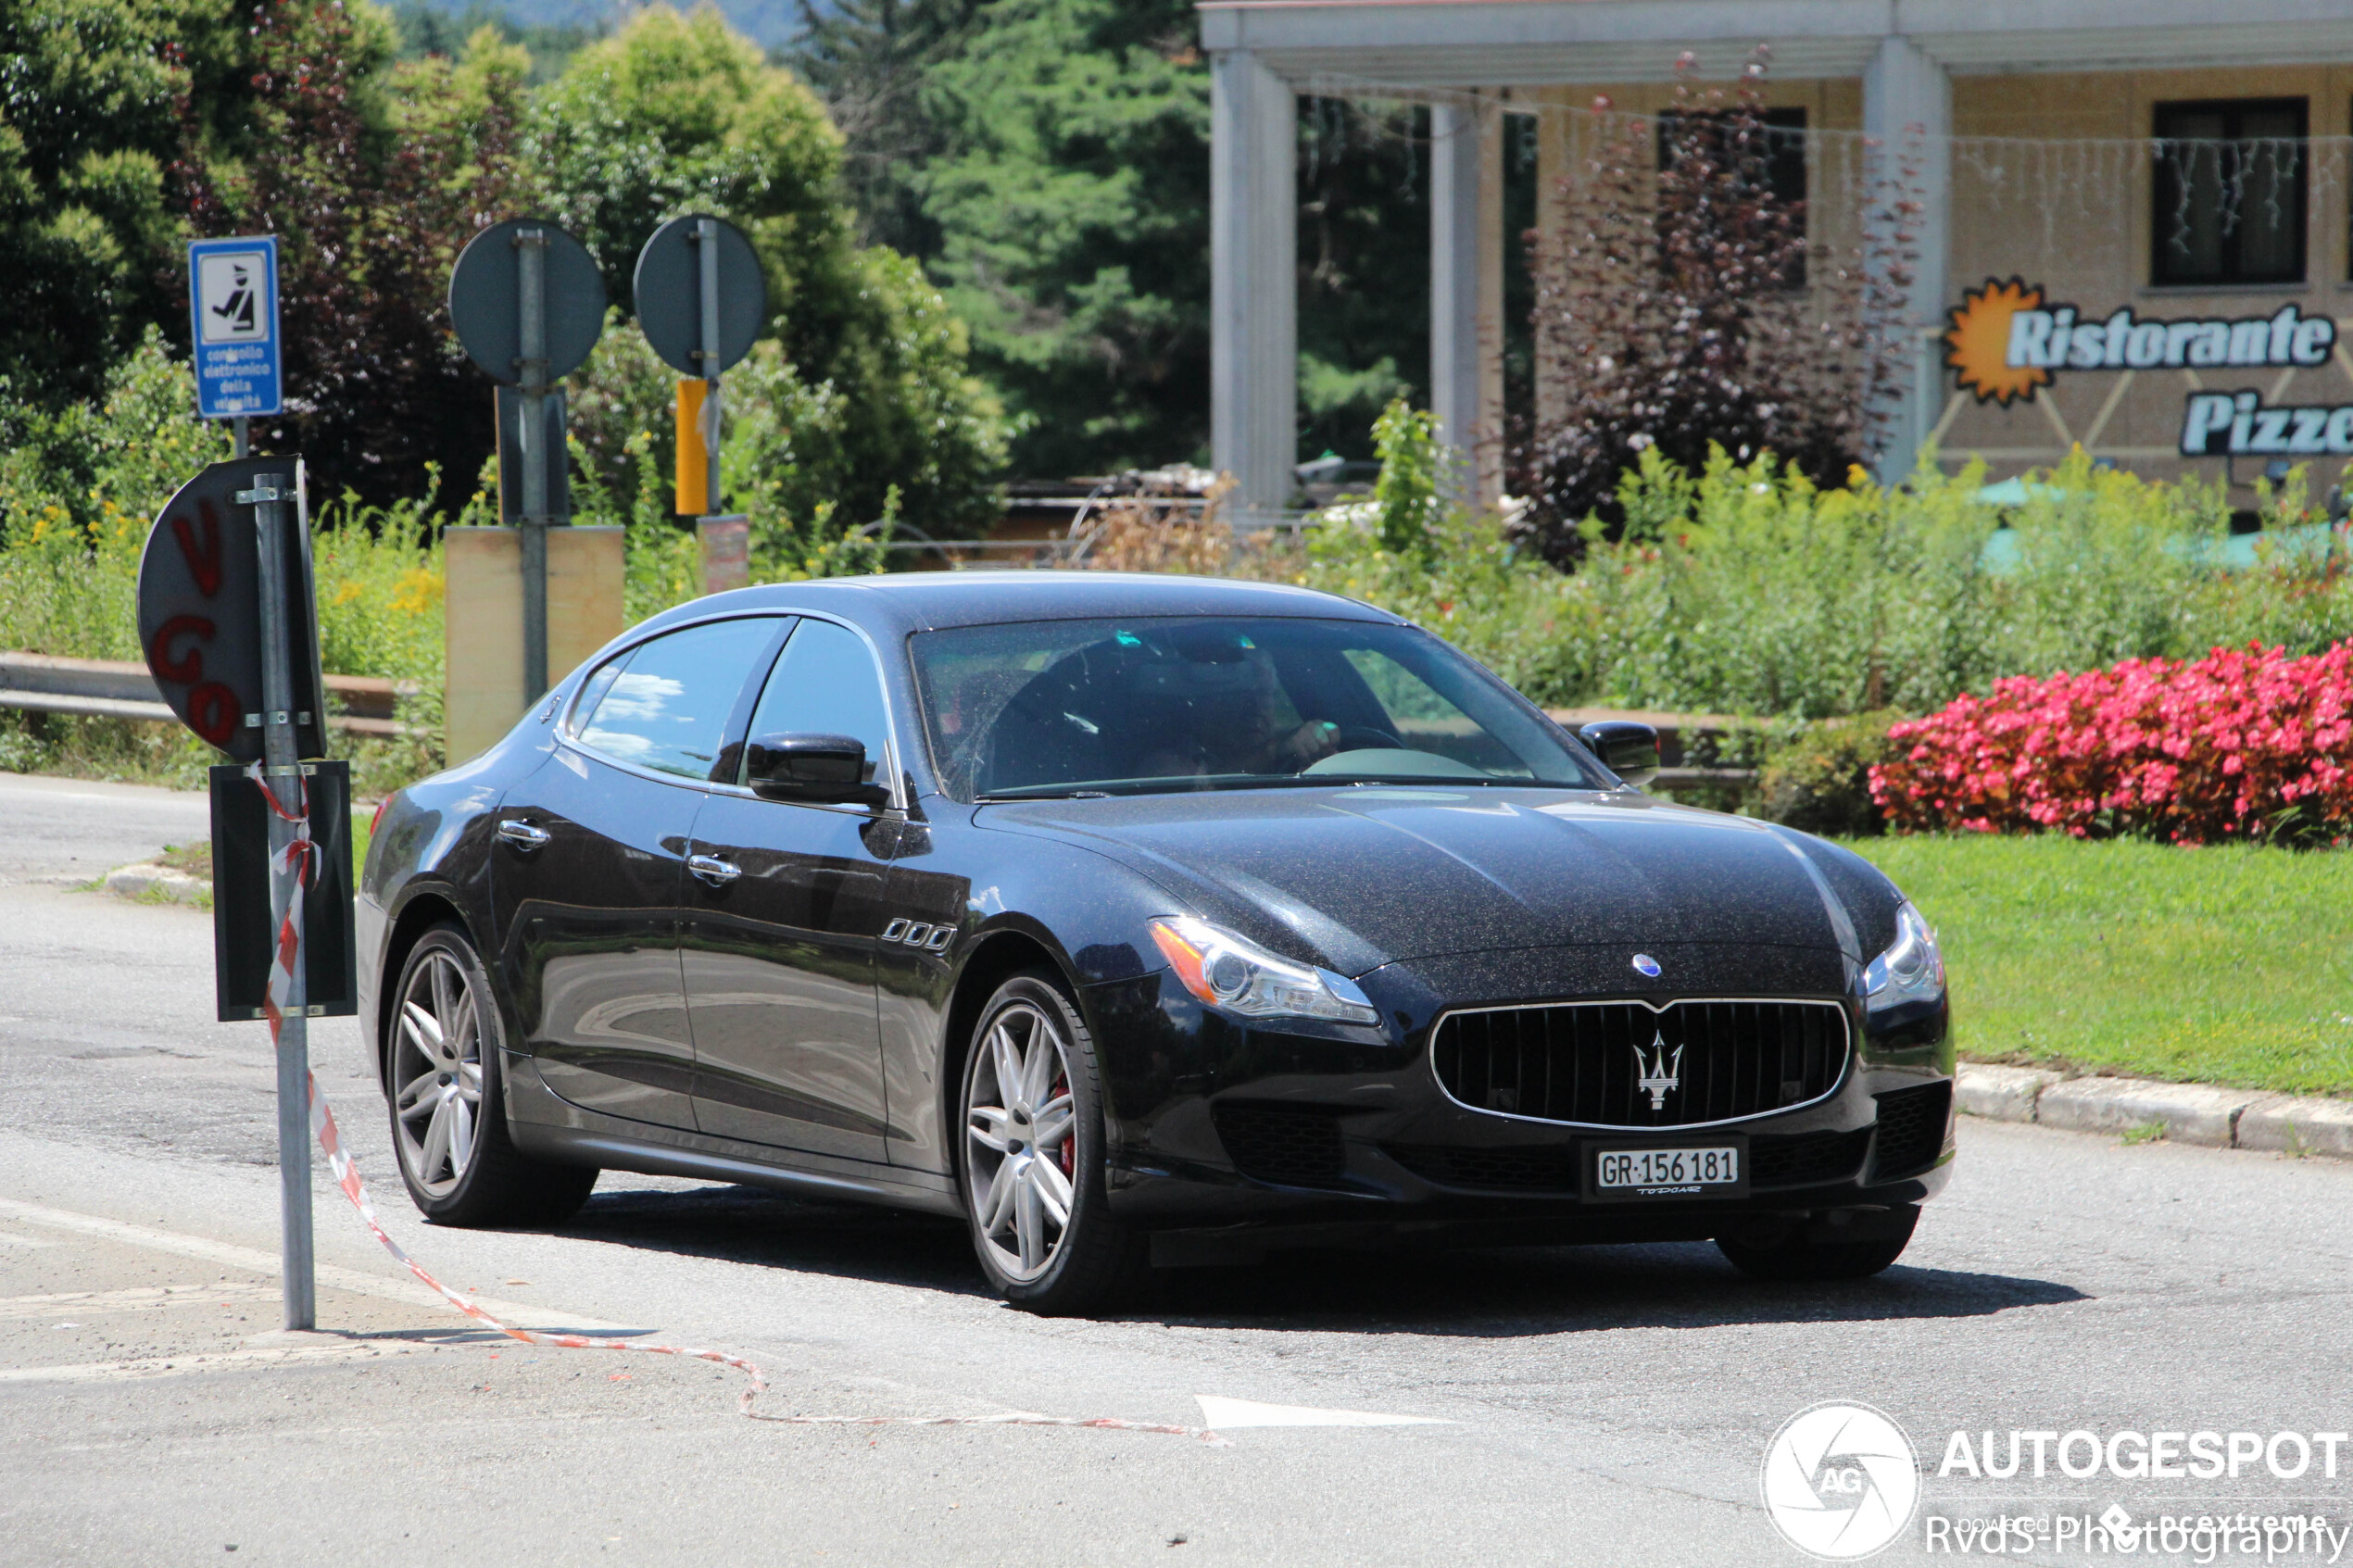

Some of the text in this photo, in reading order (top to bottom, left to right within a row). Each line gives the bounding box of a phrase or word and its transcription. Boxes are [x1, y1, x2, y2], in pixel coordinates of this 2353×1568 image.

[2006, 306, 2334, 369] Ristorante
[220, 379, 252, 394] della
[2184, 391, 2353, 453] Pizze
